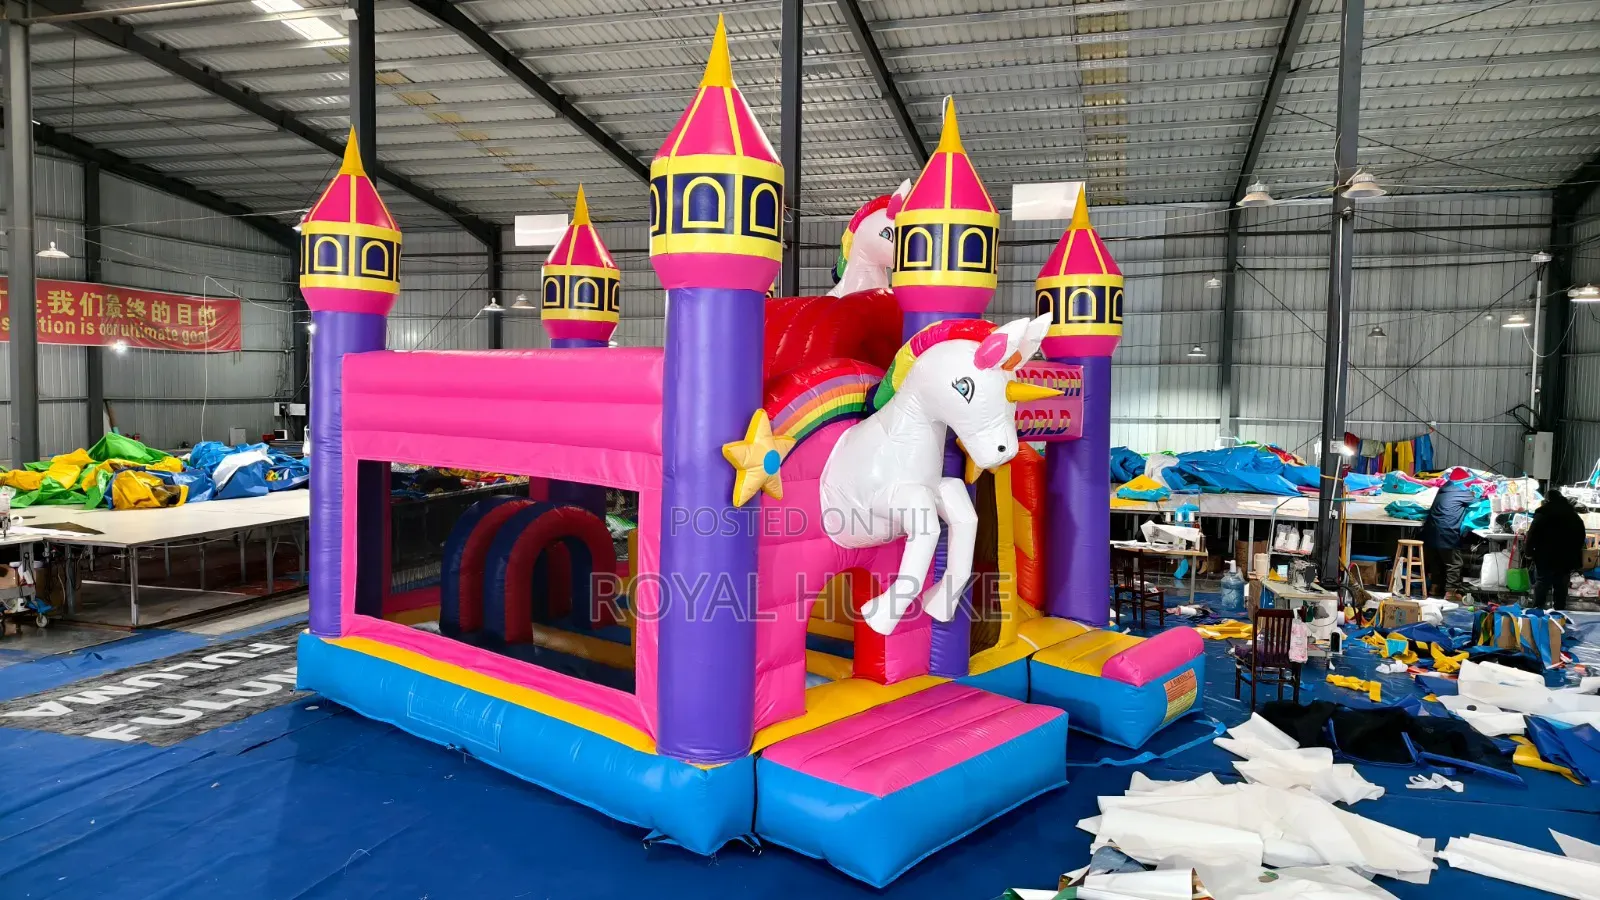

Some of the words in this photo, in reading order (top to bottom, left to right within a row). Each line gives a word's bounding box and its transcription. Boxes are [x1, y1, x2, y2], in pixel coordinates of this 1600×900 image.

[80, 317, 95, 336] is
[99, 322, 118, 337] our
[121, 321, 179, 342] ultimate
[181, 328, 210, 346] goal
[1014, 409, 1072, 437] ORLD
[1, 642, 292, 718] FULUMA
